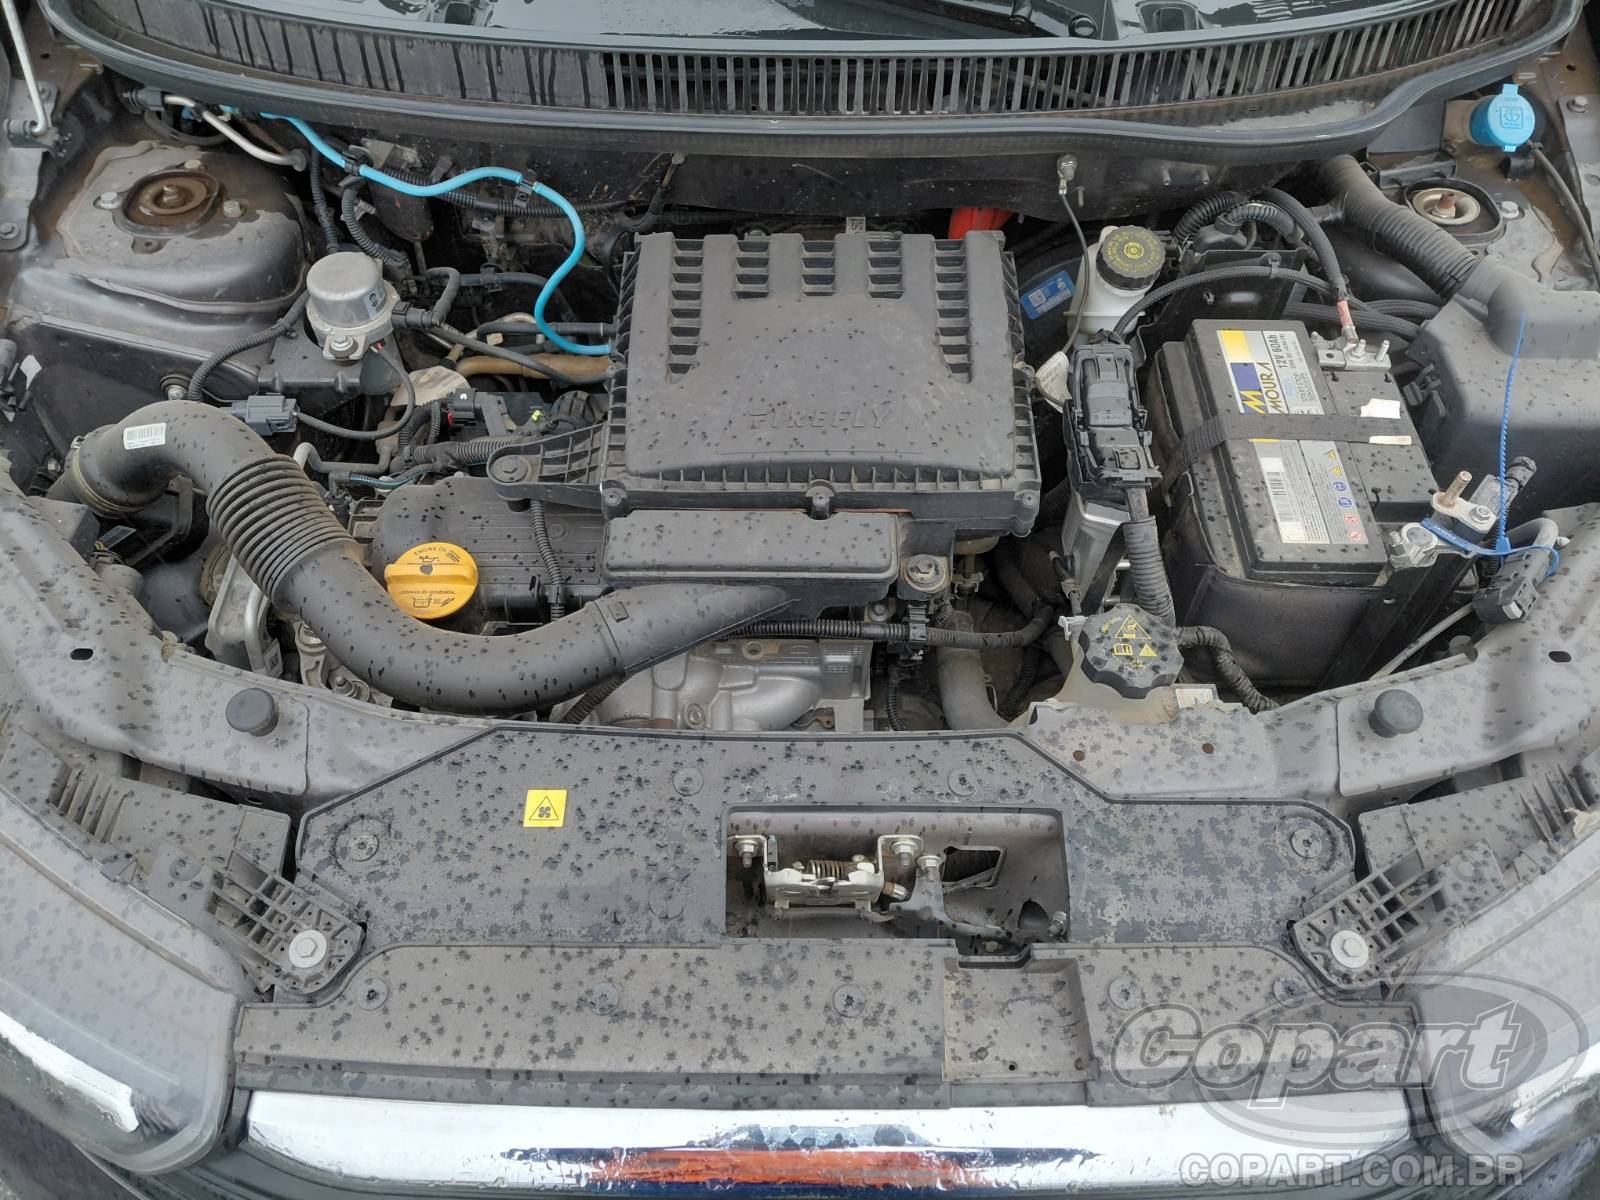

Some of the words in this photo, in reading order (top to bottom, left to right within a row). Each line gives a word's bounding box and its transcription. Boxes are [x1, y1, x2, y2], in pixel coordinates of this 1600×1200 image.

[1268, 335, 1283, 353] 60Ah
[1275, 355, 1288, 369] 12V
[1256, 362, 1288, 414] MOURA
[750, 409, 892, 429] FIREFLY
